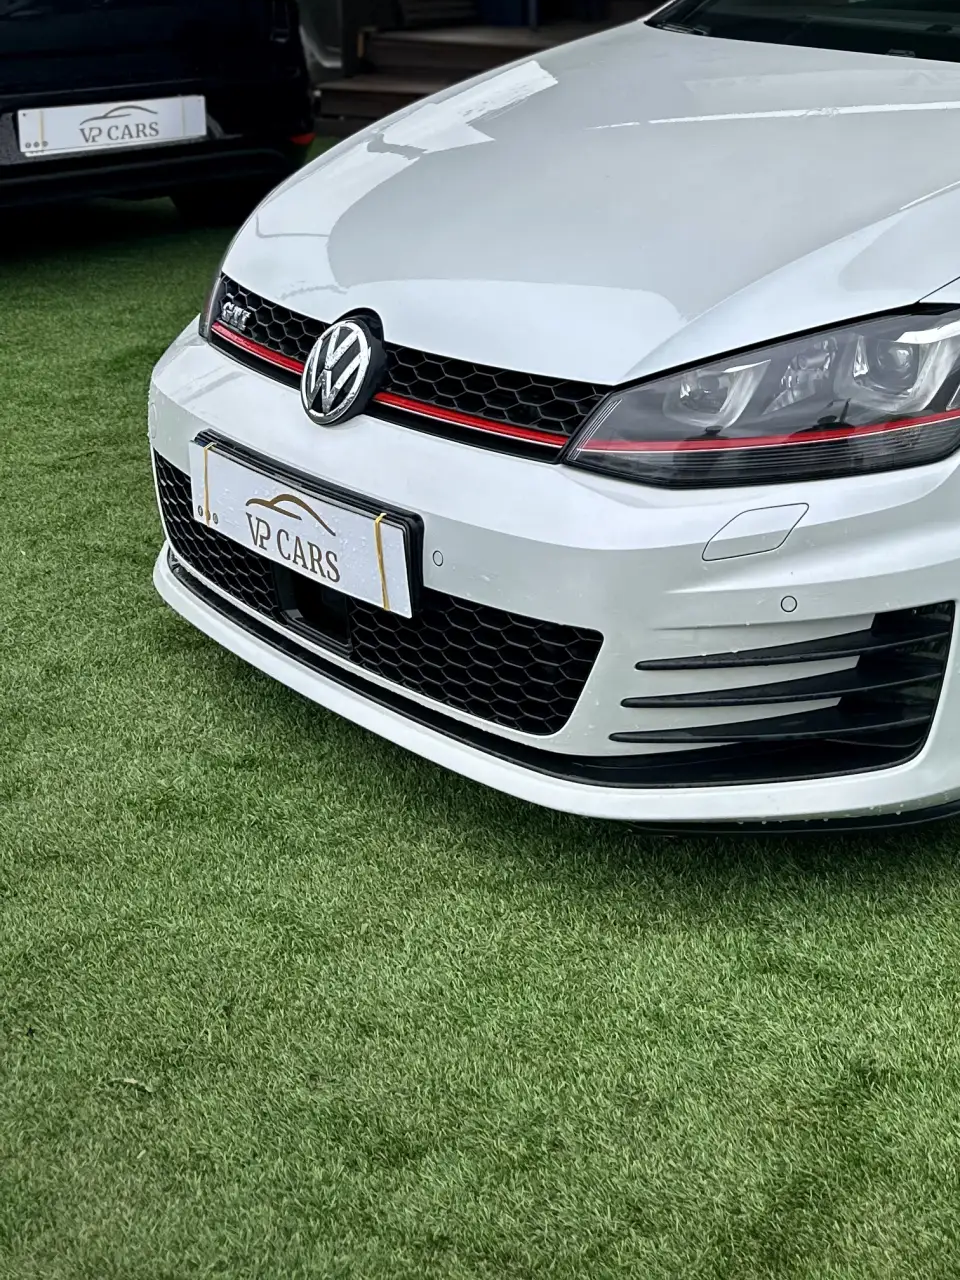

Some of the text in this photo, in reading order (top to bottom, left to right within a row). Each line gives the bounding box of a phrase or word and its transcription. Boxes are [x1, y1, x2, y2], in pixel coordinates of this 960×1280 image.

[80, 122, 160, 143] VP CARS
[246, 512, 340, 583] VP CARS
